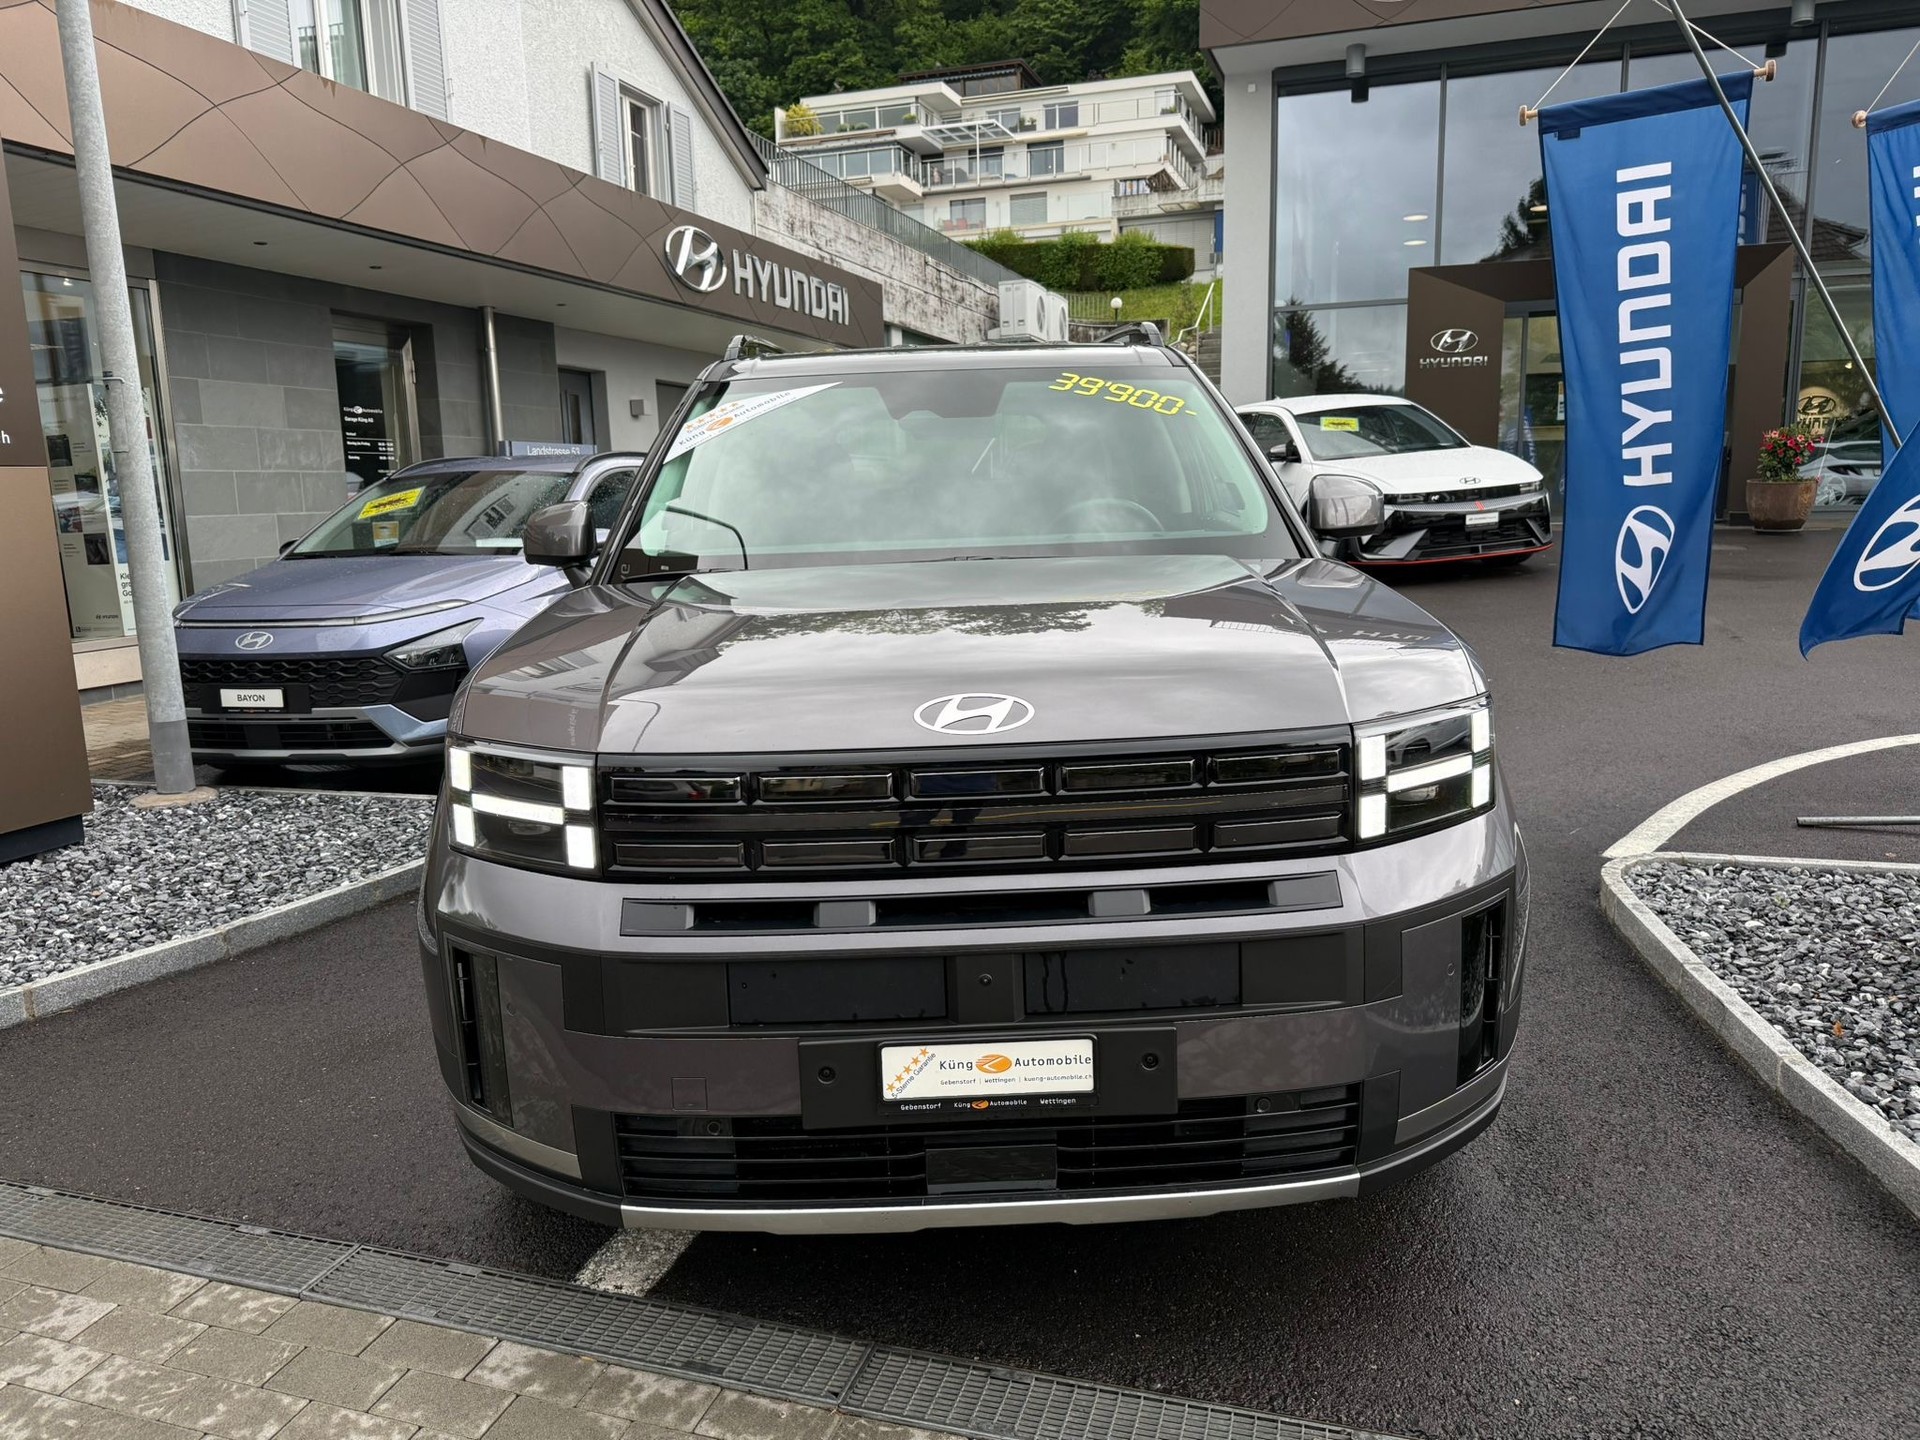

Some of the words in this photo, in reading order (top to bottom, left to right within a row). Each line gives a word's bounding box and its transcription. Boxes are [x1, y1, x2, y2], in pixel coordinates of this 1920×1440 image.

[732, 249, 849, 325] HYUNDAI
[1616, 161, 1672, 486] HYUNDAI
[1419, 355, 1488, 369] HYUNDAI
[527, 445, 570, 456] Landstrasse
[237, 694, 266, 702] BAYON
[913, 1052, 937, 1076] Garantie
[939, 1059, 973, 1071] Küng
[1014, 1054, 1092, 1067] Automobile
[940, 1078, 976, 1086] Gebenstorf
[900, 1103, 942, 1111] Gebenstorf
